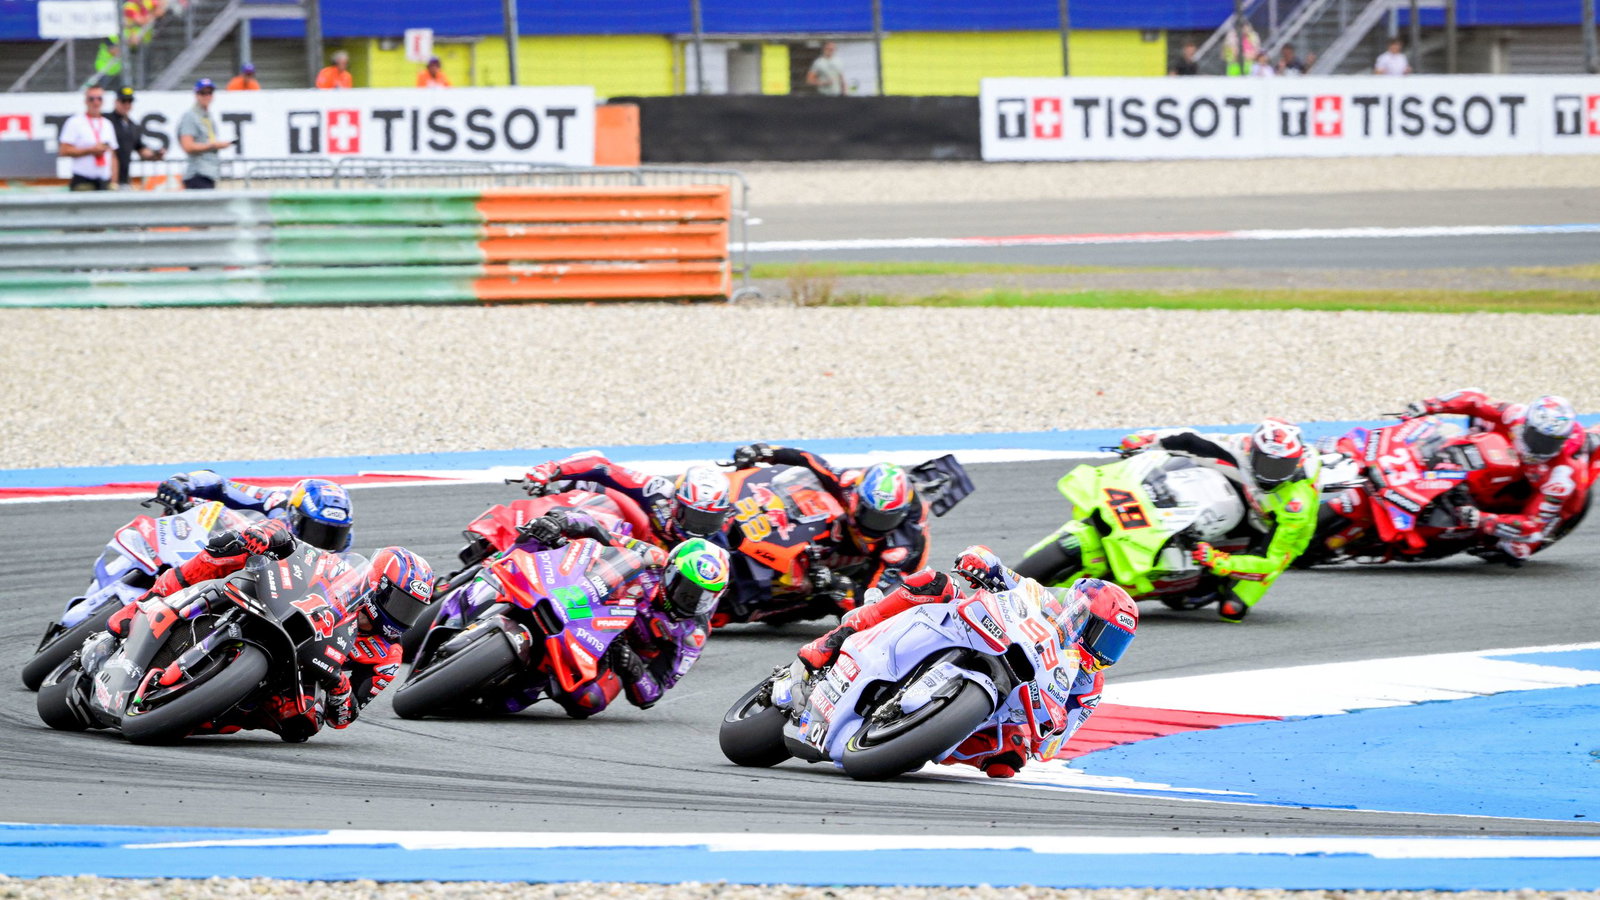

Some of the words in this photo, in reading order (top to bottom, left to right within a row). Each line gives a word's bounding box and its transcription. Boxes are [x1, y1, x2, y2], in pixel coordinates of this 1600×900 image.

[372, 108, 576, 151] TISSOT
[1073, 98, 1251, 138] TISSOT
[1352, 96, 1525, 135] TISSOT
[1379, 447, 1420, 487] 23
[267, 570, 276, 592] CASE
[537, 552, 556, 585] prima
[411, 580, 431, 595] Arai
[581, 580, 599, 603] prima
[290, 593, 335, 639] 12
[549, 585, 594, 620] 21
[576, 627, 605, 652] prima
[983, 617, 1002, 638] BOLD
[1019, 617, 1060, 671] 93
[312, 658, 328, 671] CASE
[1029, 681, 1040, 702] BOLD
[1047, 683, 1066, 704] Unibat
